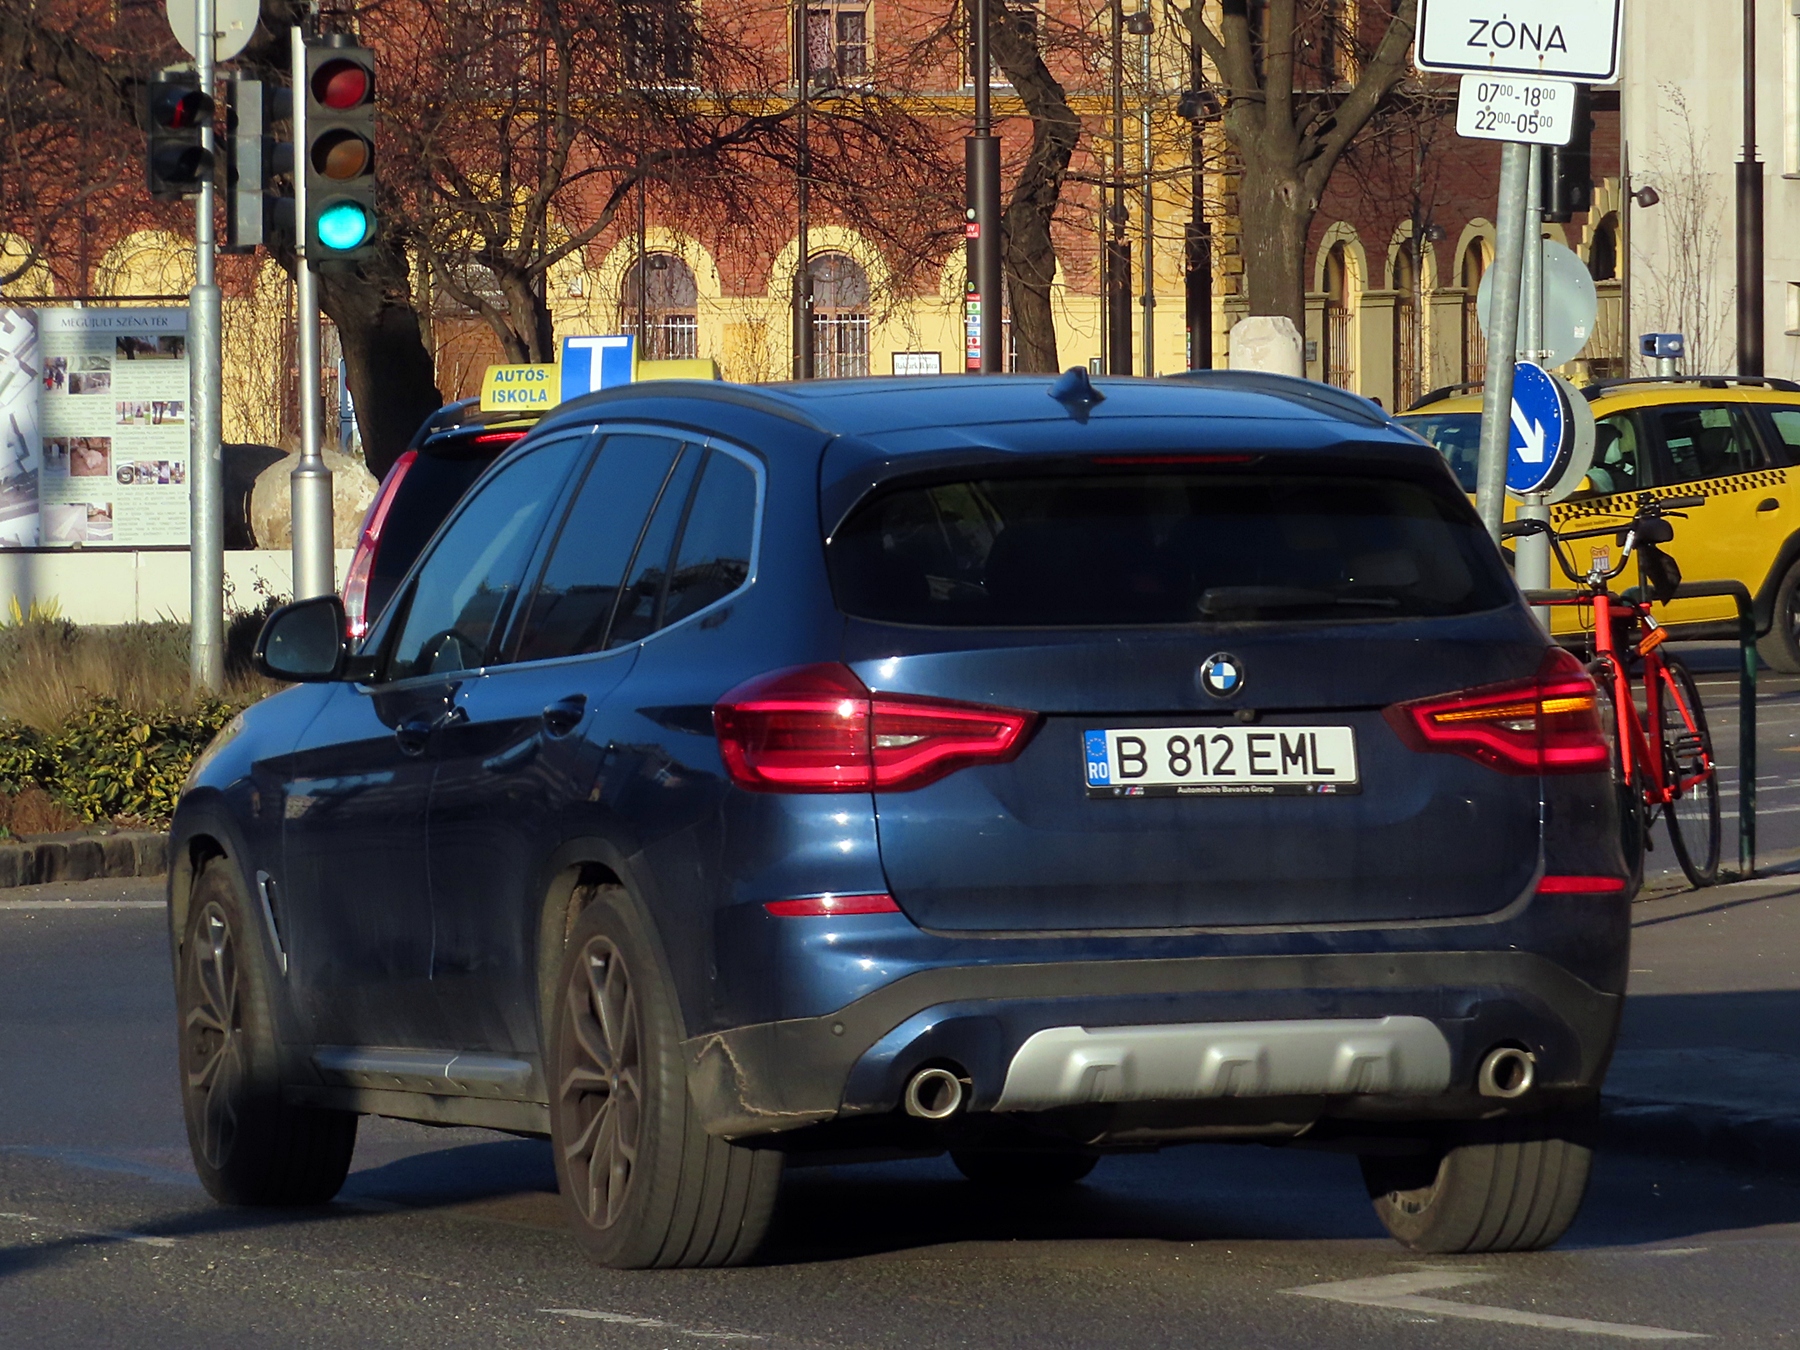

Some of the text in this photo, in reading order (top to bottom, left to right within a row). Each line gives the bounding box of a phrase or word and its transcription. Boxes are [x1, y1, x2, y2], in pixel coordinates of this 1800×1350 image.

[1467, 13, 1567, 53] ZÓNA
[61, 315, 168, 328] MEGÚJULT SZÉNA TÉR
[568, 336, 628, 393] T
[494, 368, 549, 382] AUTÓS-
[492, 389, 548, 403] ISKOLA
[1116, 733, 1335, 778] B 812 EML
[1088, 761, 1109, 780] RO
[1222, 785, 1250, 793] Bavaria
[1251, 785, 1274, 794] Group
